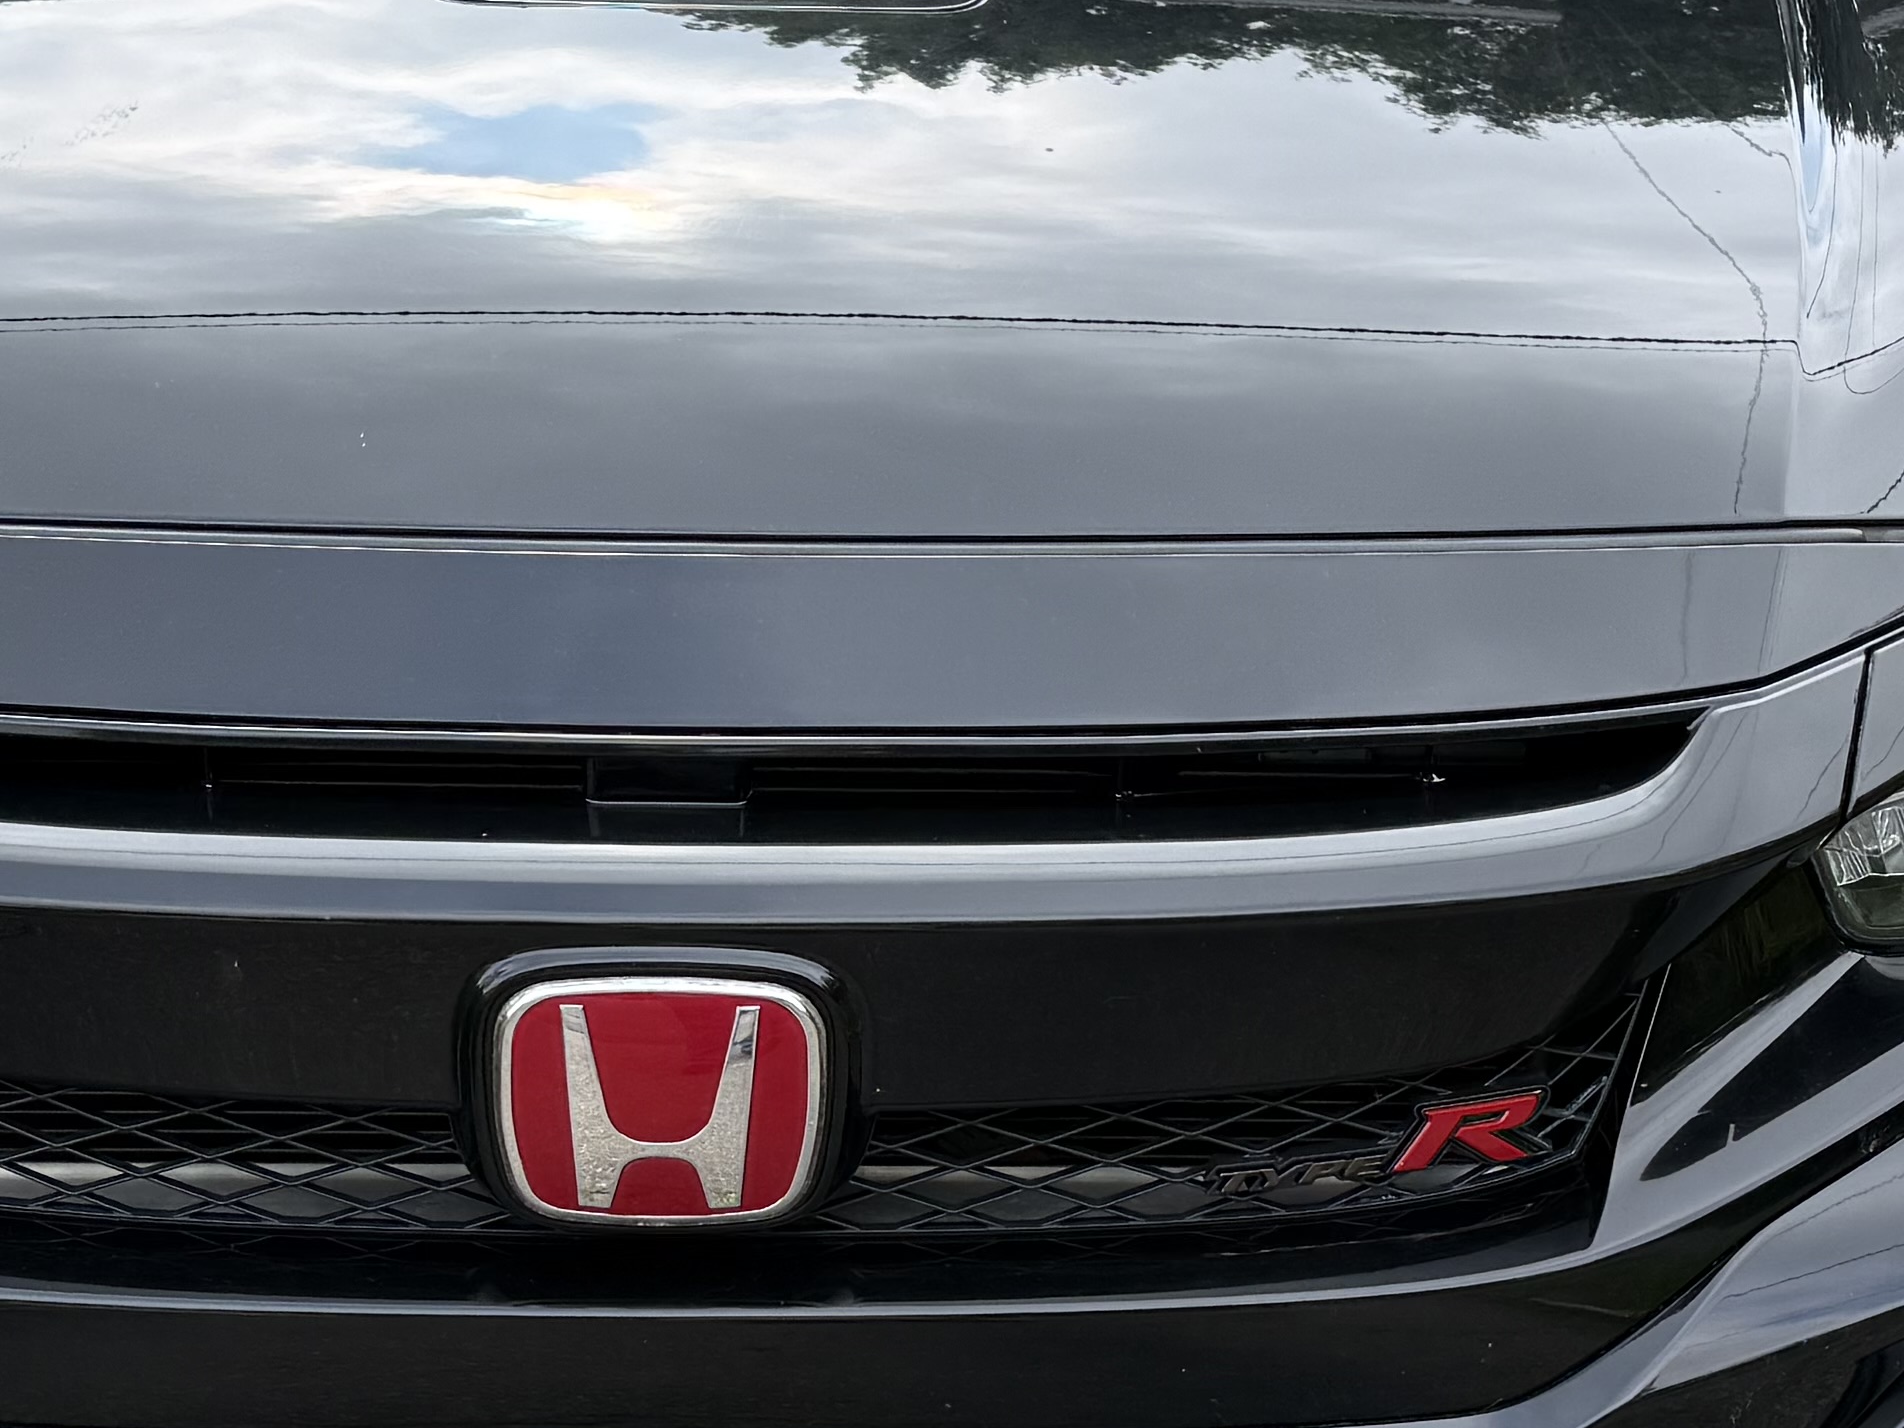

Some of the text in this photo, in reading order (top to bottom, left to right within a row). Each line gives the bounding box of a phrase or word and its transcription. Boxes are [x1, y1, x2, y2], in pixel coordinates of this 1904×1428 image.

[559, 1003, 761, 1209] H
[1214, 1092, 1542, 1194] TYPE R
